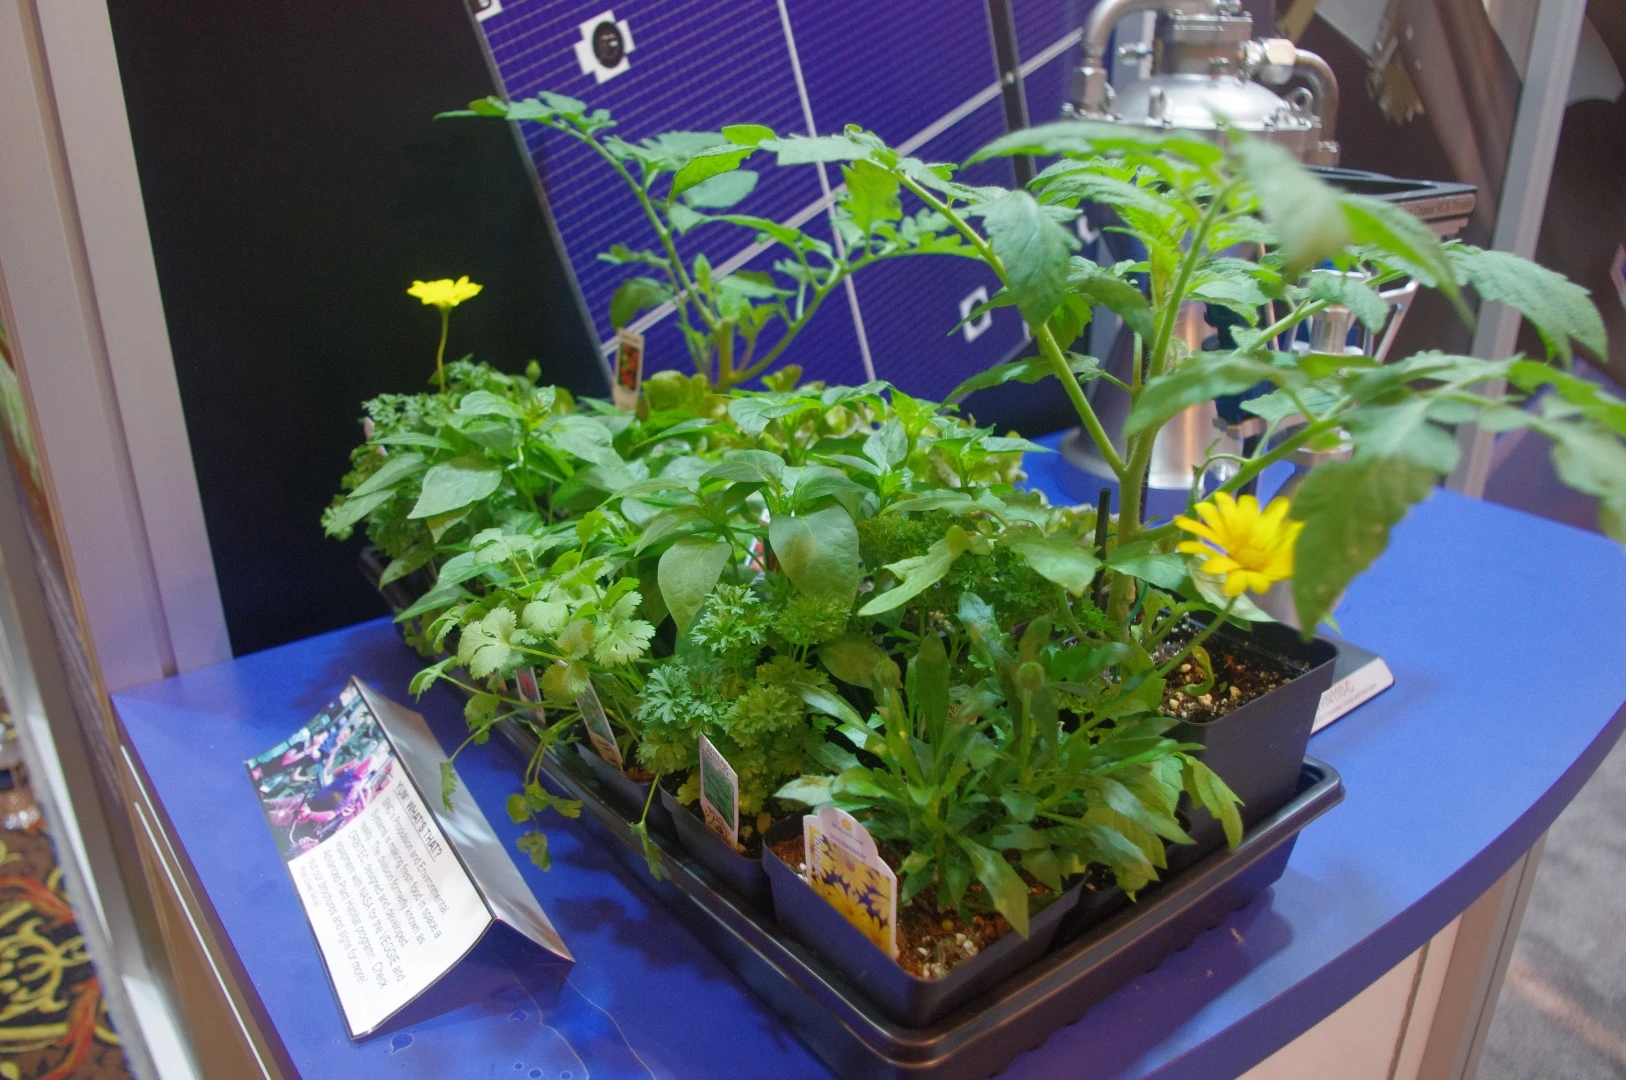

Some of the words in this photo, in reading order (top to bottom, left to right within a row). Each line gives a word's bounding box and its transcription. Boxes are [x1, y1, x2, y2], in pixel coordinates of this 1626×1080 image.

[394, 780, 410, 802] YUM!
[405, 800, 427, 833] WHAT'S
[422, 828, 442, 857] THAT?
